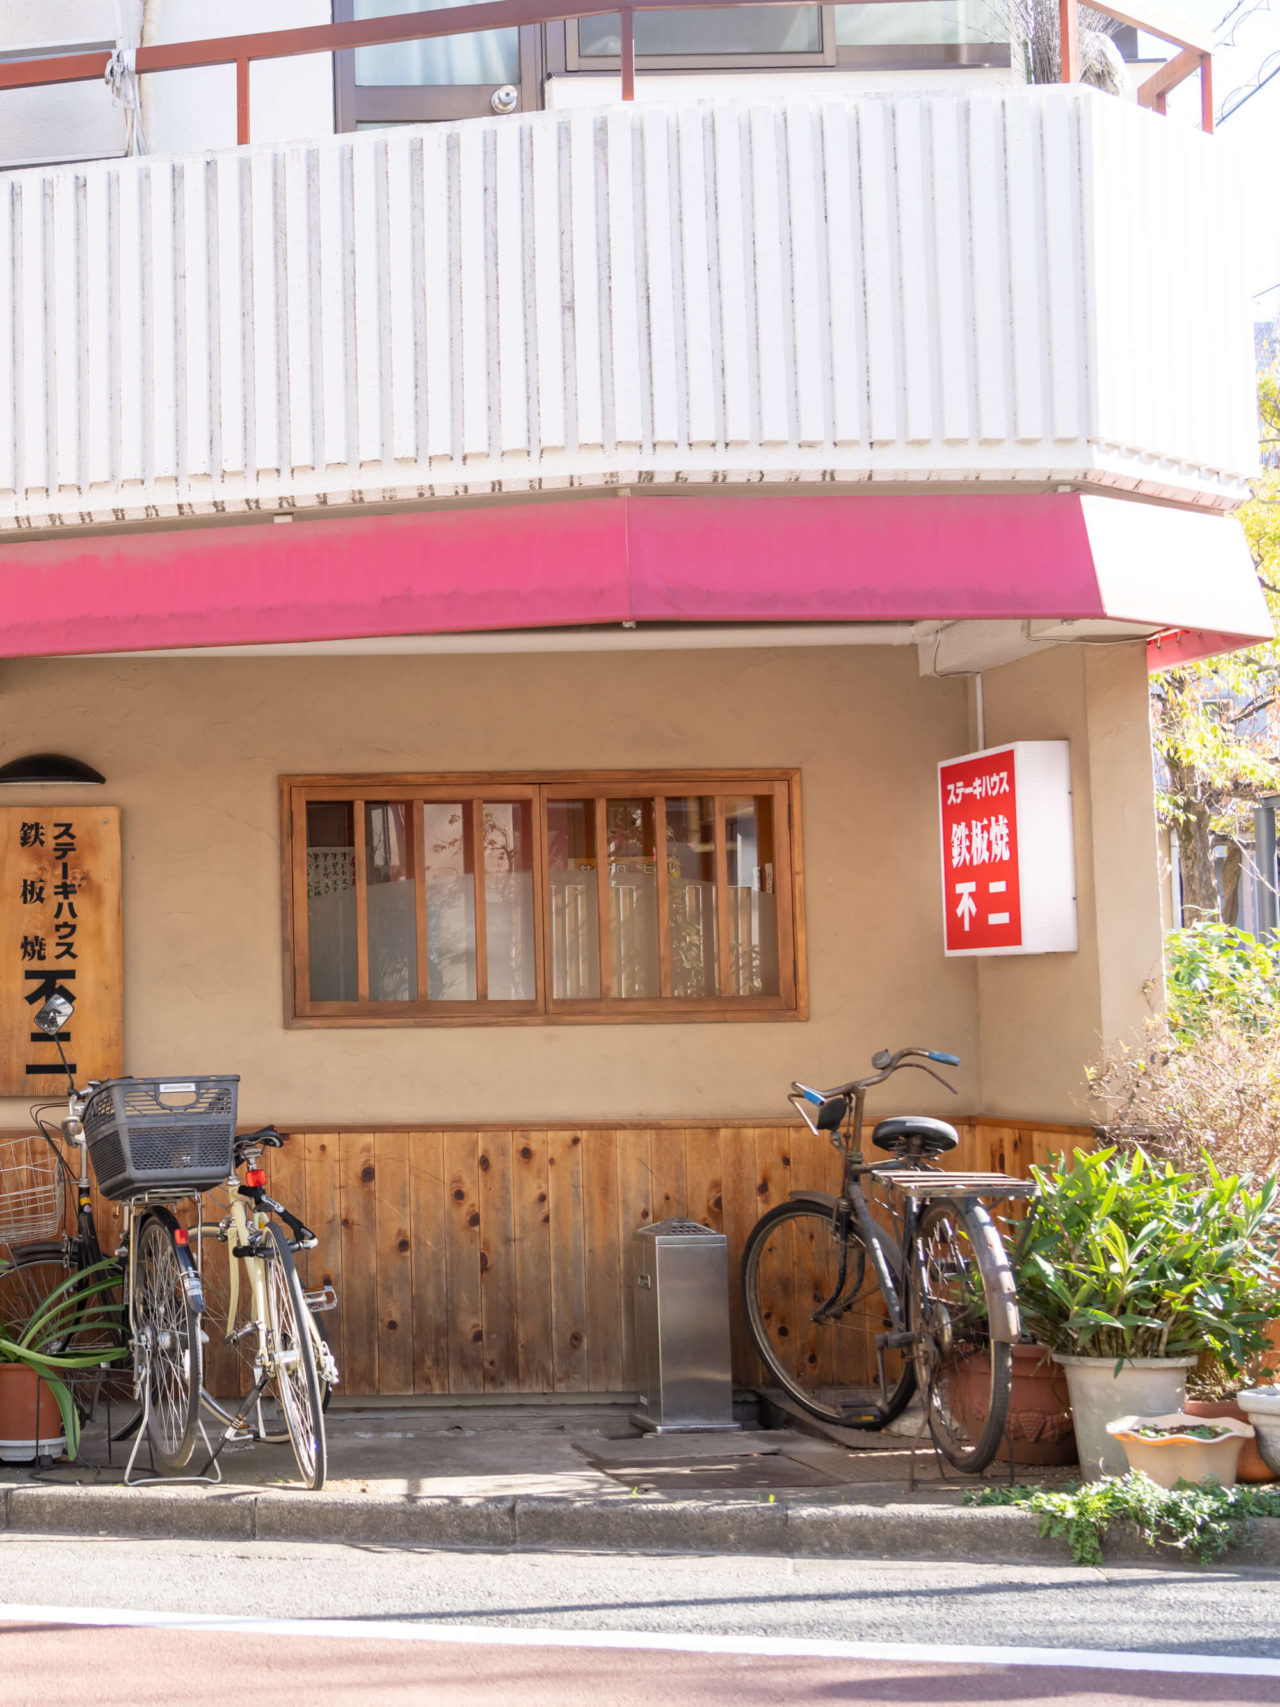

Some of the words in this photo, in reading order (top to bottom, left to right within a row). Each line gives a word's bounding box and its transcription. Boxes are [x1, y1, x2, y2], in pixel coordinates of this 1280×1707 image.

[946, 771, 1010, 805] ステーキハウス
[950, 814, 1011, 868] 鉄板焼
[20, 821, 47, 963] 鉄板焼
[53, 822, 78, 960] ステーキハウス
[955, 880, 1010, 931] 不二
